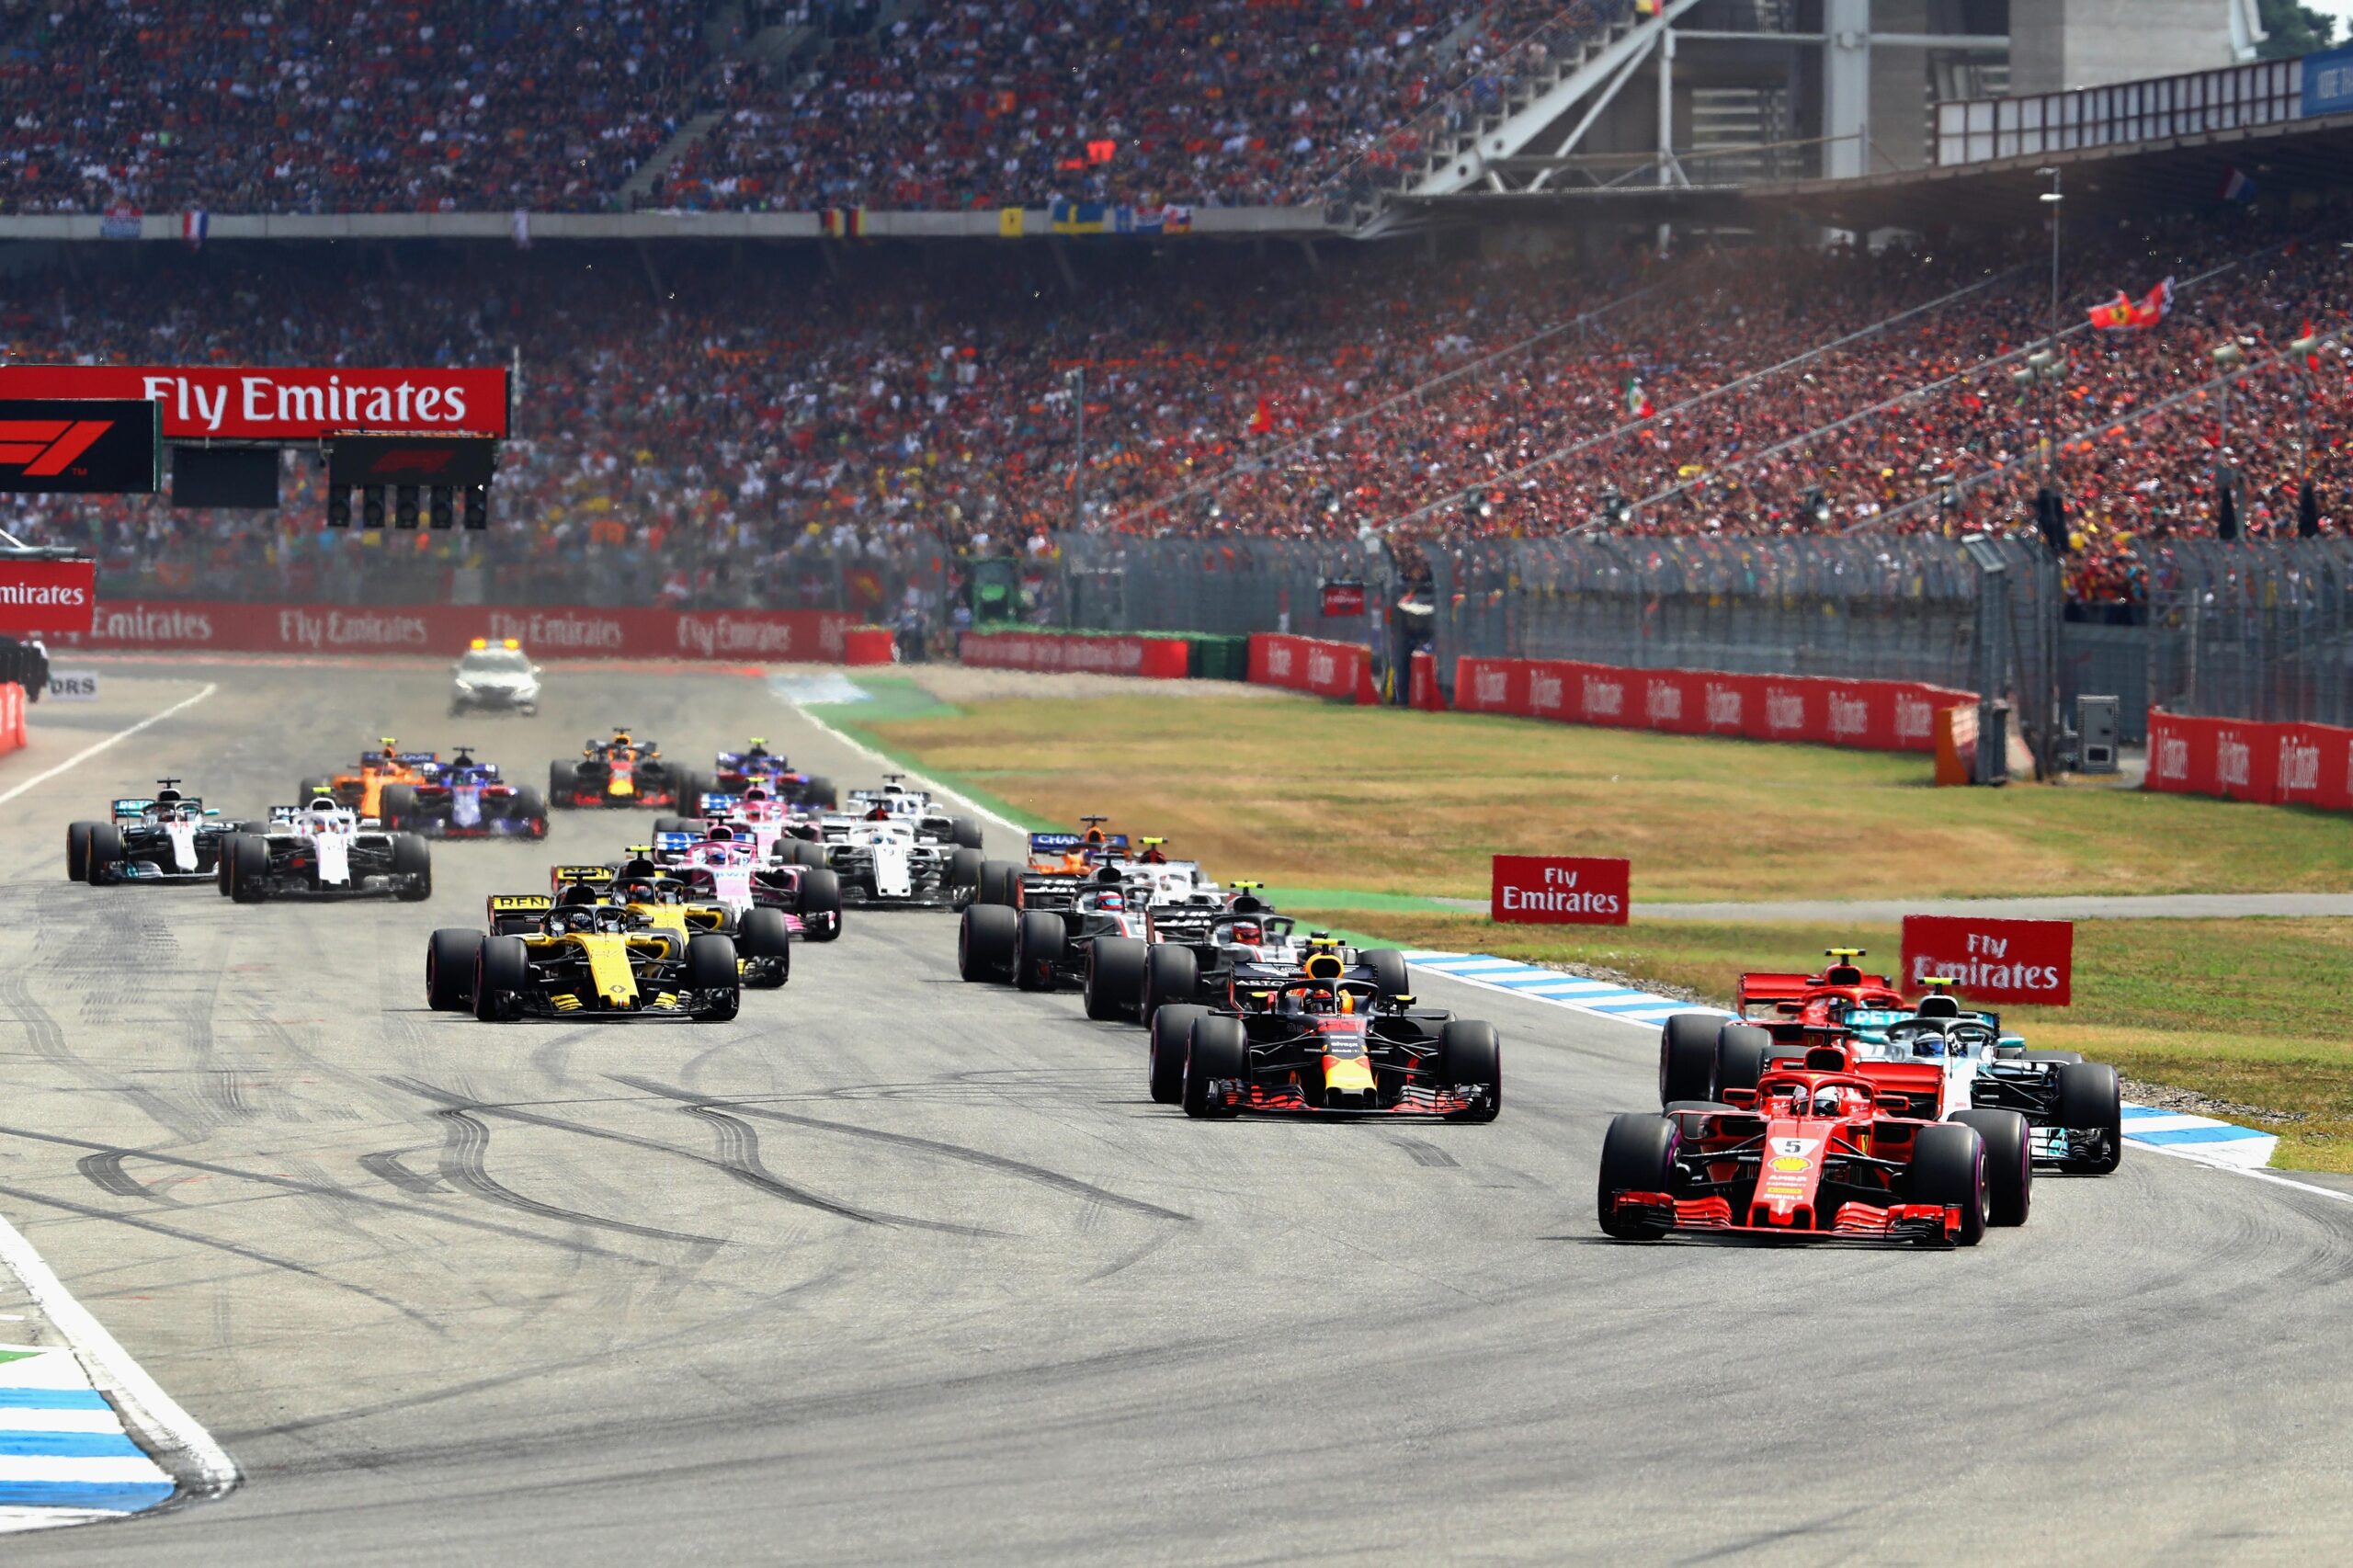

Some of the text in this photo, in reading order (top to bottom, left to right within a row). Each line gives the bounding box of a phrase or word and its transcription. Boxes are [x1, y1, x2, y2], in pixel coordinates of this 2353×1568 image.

[142, 375, 466, 430] Fly Emirates
[93, 606, 213, 640] Emirates
[1544, 868, 1577, 888] Fly
[1503, 886, 1619, 913] Emirates
[1967, 933, 2007, 959] Fly
[1914, 955, 2060, 989] Emirates
[1784, 1141, 1802, 1153] 5
